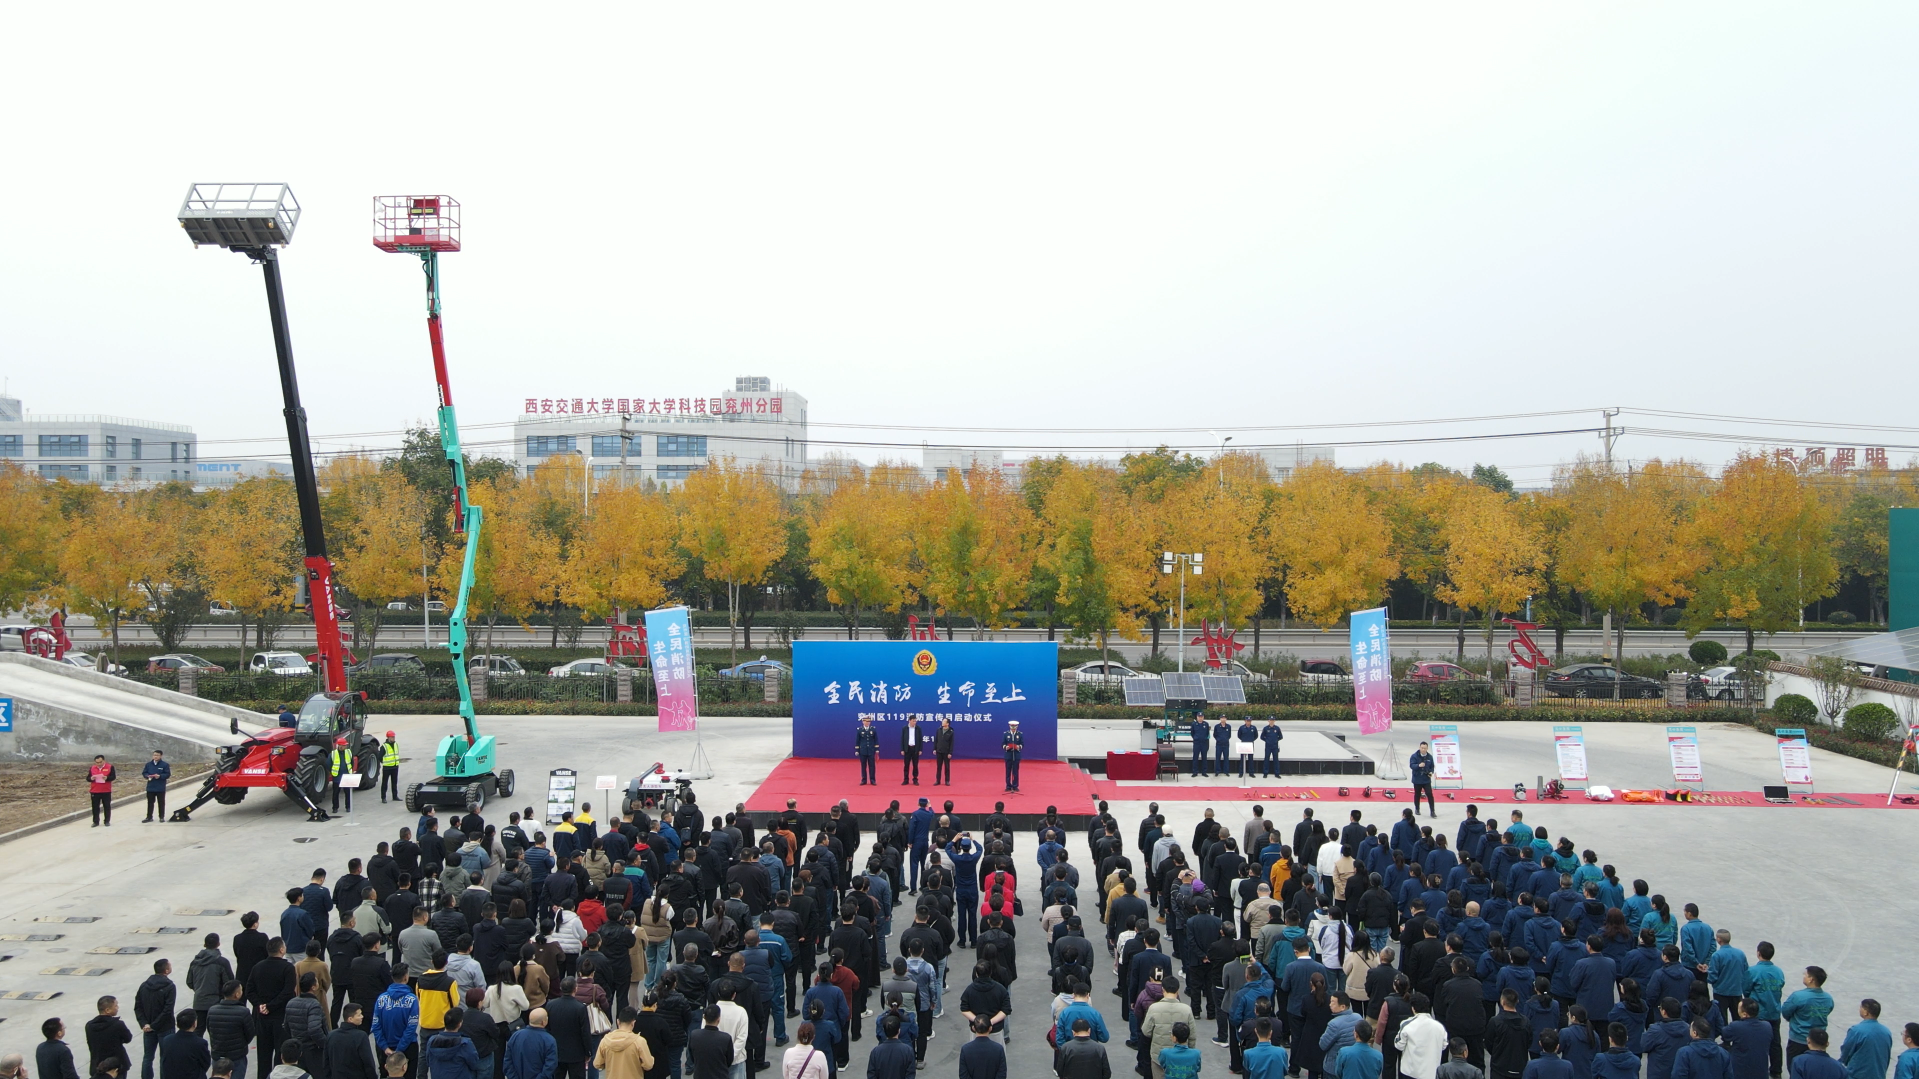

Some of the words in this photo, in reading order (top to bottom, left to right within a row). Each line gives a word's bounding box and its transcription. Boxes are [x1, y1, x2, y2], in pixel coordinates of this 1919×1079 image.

[525, 398, 782, 414] 西安交通大学国家大学科技园兖州分园
[823, 680, 912, 705] 全民消防
[937, 680, 1027, 708] 生命至上
